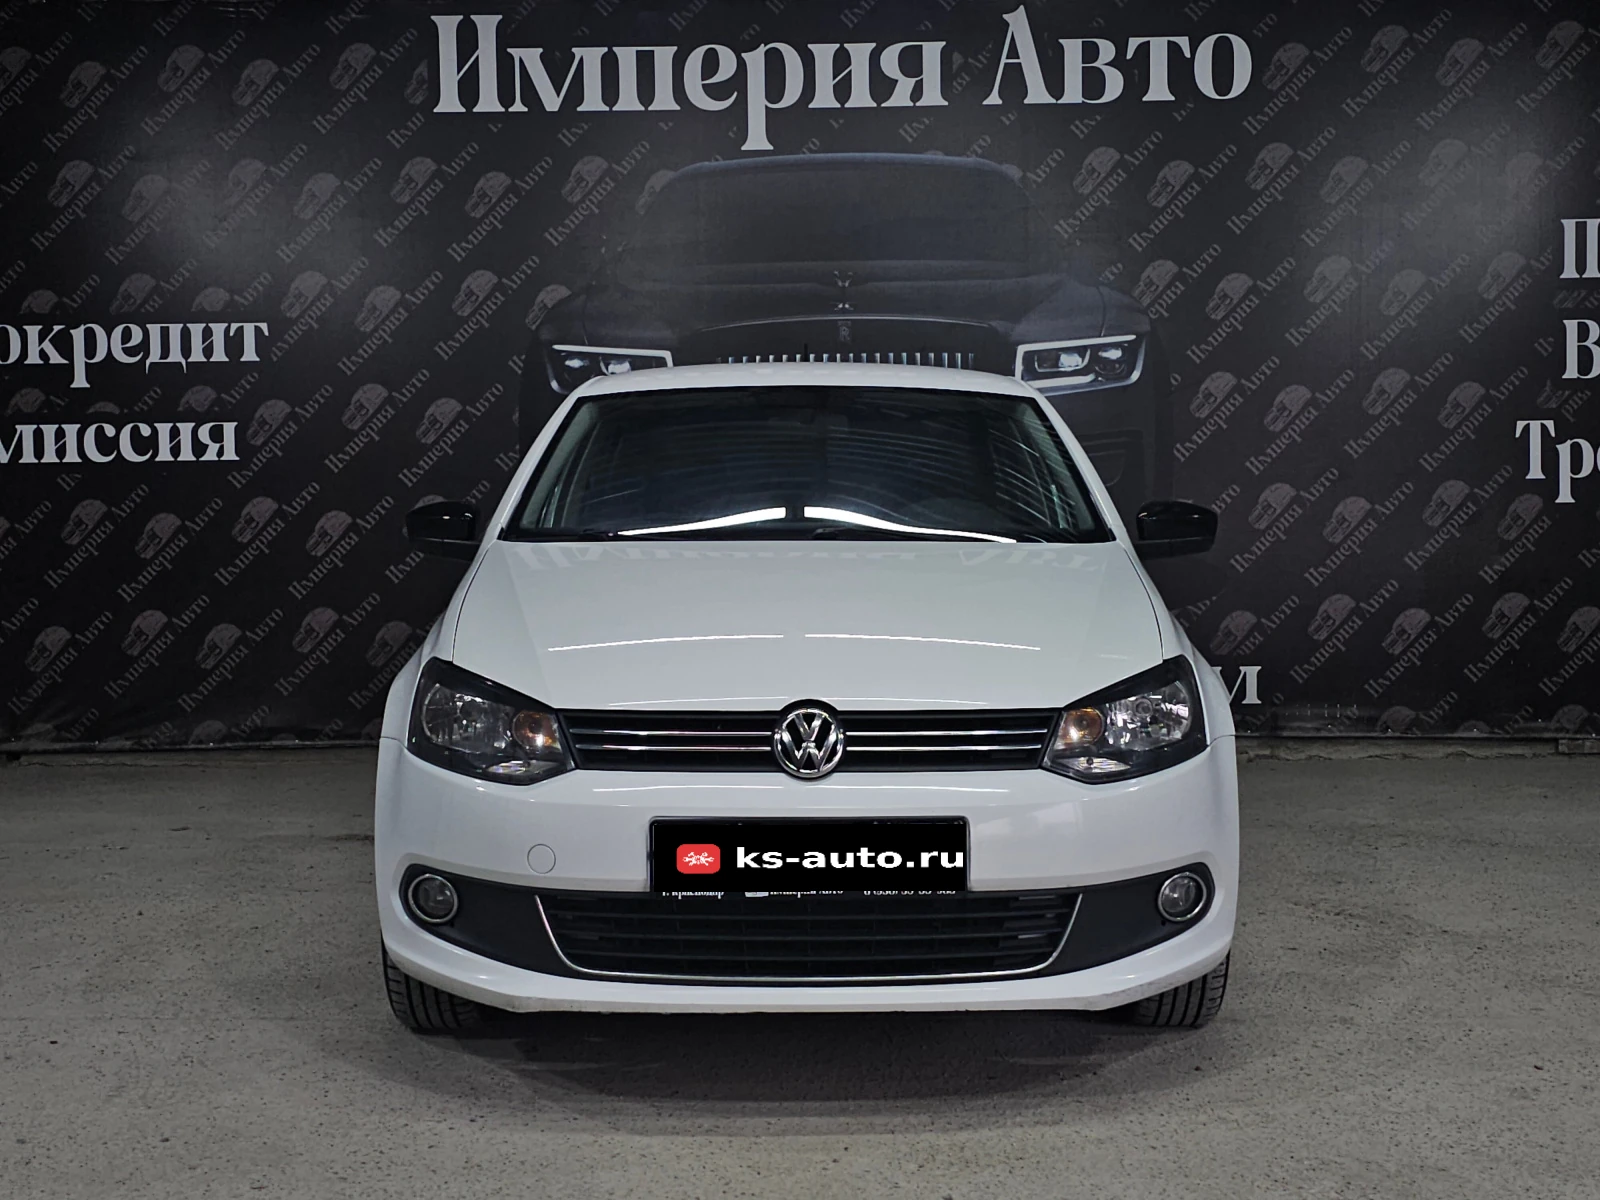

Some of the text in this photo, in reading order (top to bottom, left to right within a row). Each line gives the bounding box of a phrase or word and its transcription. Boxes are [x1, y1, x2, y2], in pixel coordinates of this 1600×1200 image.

[0, 31, 73, 117] ерия Авто
[41, 46, 148, 152] Империя Авто
[140, 66, 212, 136] Империя
[208, 30, 246, 69] Авто
[214, 45, 321, 151] Империя Авто
[312, 65, 384, 135] Империя
[379, 29, 418, 68] Авто
[430, 4, 1252, 151] Империя Авто
[1243, 65, 1316, 135] Империя
[1312, 29, 1351, 68] Авто
[1342, 10, 1450, 116] Империя Авто
[1417, 60, 1490, 130] Империя
[1486, 24, 1525, 63] Авто
[1518, 41, 1592, 111] Империя
[0, 161, 37, 200] Авто
[30, 145, 136, 251] Империя Авто
[276, 158, 382, 264] Империя Авто
[372, 178, 445, 248] Империя
[440, 142, 479, 181] Авто
[447, 157, 554, 262] Империя Авто
[542, 176, 615, 246] Империя
[610, 140, 649, 179] Авто
[1054, 132, 1161, 237] Империя Авто
[1128, 146, 1236, 251] Империя Авто
[1226, 128, 1334, 234] Империя Авто
[0, 259, 26, 295] вто
[61, 274, 100, 313] Авто
[159, 258, 198, 297] Авто
[233, 272, 272, 312] Авто
[330, 256, 369, 296] Авто
[336, 271, 443, 376] Империя Авто
[432, 255, 539, 360] Империя Авто
[1147, 244, 1220, 318] ерия Авто
[1187, 258, 1295, 363] Империя Авто
[1359, 254, 1467, 359] Империя Авто
[1459, 273, 1533, 342] Империя
[220, 370, 259, 409] Авто
[227, 384, 333, 489] Империя Авто
[323, 368, 430, 473] Империя Авто
[397, 418, 469, 487] Империя
[465, 382, 504, 421] Авто
[1171, 356, 1279, 461] Империя Авто
[1245, 370, 1353, 474] Империя Авто
[1343, 353, 1452, 458] Империя Авто
[1418, 403, 1492, 471] Империя
[1487, 367, 1526, 406] Авто
[1211, 484, 1241, 514] вто
[1515, 419, 1600, 503] Тр
[12, 500, 51, 539] Авто
[43, 519, 115, 587] Империя
[110, 483, 149, 522] Авто
[117, 498, 223, 602] Империя Авто
[213, 481, 320, 585] Империя Авто
[287, 531, 359, 599] Империя
[355, 495, 394, 534] Авто
[1230, 468, 1338, 572] Империя Авто
[1304, 481, 1412, 585] Империя Авто
[1403, 465, 1511, 569] Империя Авто
[1477, 515, 1551, 583] Империя
[0, 596, 39, 635] Авто
[104, 594, 210, 698] Империя Авто
[177, 608, 284, 712] Империя Авто
[273, 592, 380, 695] Империя Авто
[1261, 595, 1300, 634] Авто
[1289, 615, 1363, 683] Империя
[1358, 579, 1397, 618] Авто
[1364, 593, 1472, 696] Империя Авто
[1463, 577, 1571, 681] Империя Авто
[1537, 632, 1600, 698] Импери
